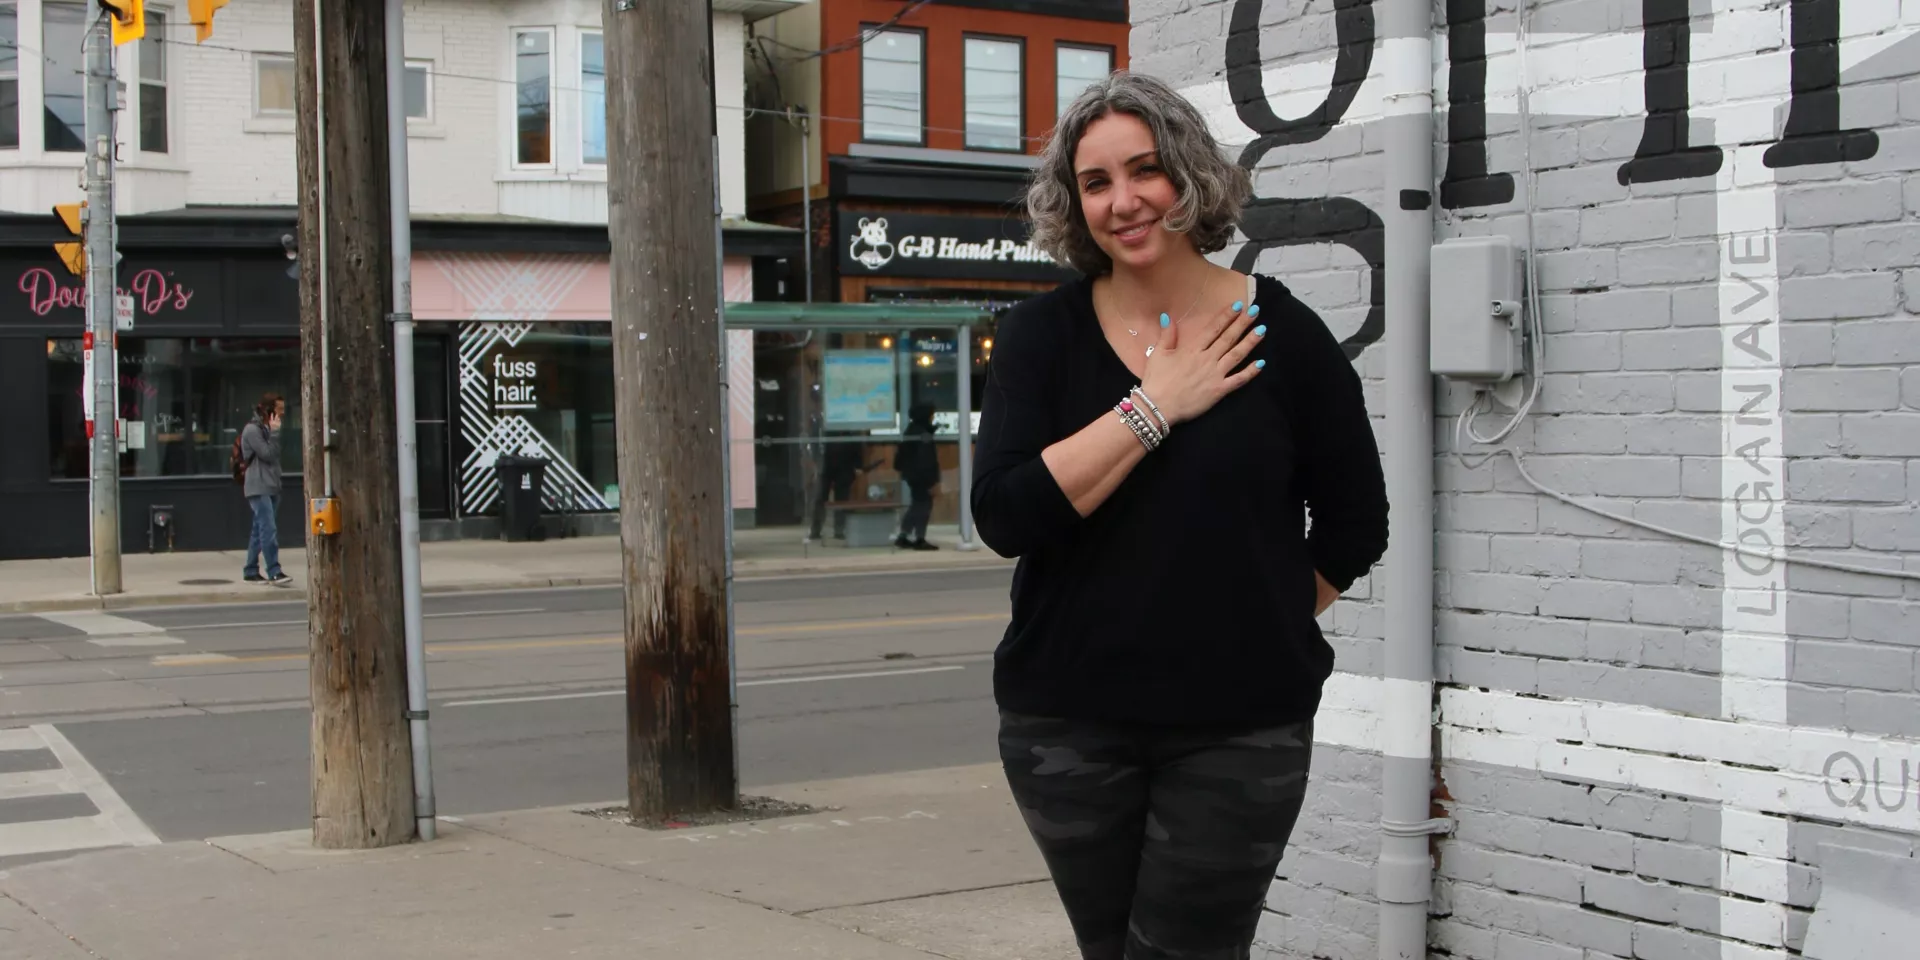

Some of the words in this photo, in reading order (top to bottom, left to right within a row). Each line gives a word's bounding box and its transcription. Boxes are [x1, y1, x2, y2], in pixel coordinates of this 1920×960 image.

[898, 235, 936, 259] G-B
[1728, 231, 1773, 362] AVE
[493, 353, 537, 378] fuss
[494, 379, 537, 401] hair.
[1732, 383, 1778, 617] LOGAN
